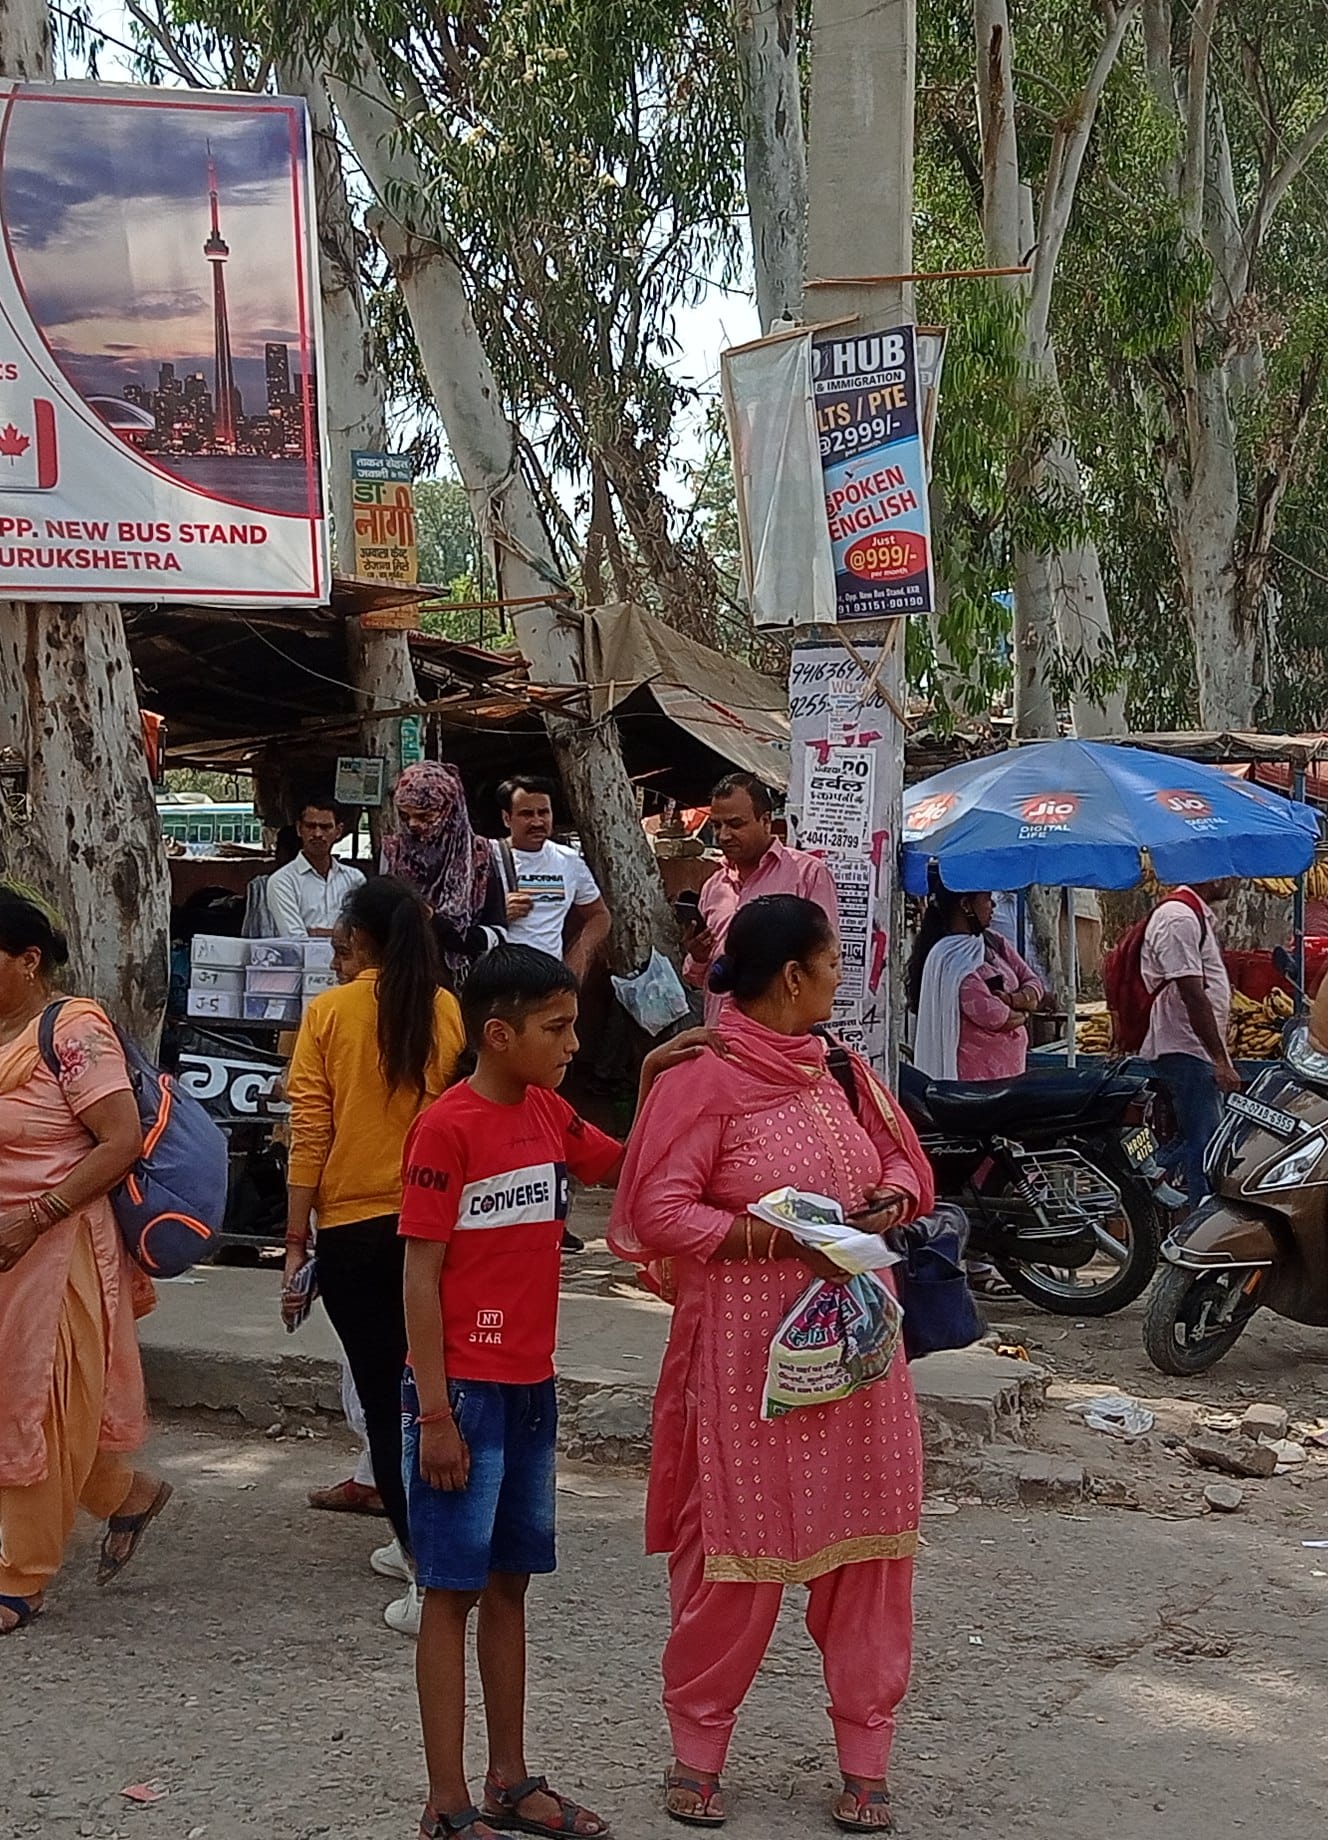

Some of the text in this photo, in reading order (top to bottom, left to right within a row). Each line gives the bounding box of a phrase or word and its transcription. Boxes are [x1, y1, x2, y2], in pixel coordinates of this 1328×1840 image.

[833, 334, 906, 376] HUB
[827, 371, 902, 391] IMMIGRATION
[818, 402, 851, 432] LTS
[868, 384, 908, 416] PTE
[825, 465, 918, 542] SPOKEN ENGLISH
[45, 519, 109, 541] NEW
[118, 522, 172, 543] BUS
[179, 523, 268, 545] STAND
[872, 535, 896, 547] Just
[850, 544, 918, 571] @999/-
[1028, 800, 1074, 817] Jio
[1167, 797, 1205, 811] Jio
[804, 830, 859, 848] 4041-28799
[1018, 824, 1072, 840] DIGITAL LIFE
[482, 1312, 500, 1326] NY
[469, 1331, 503, 1345] STAR
